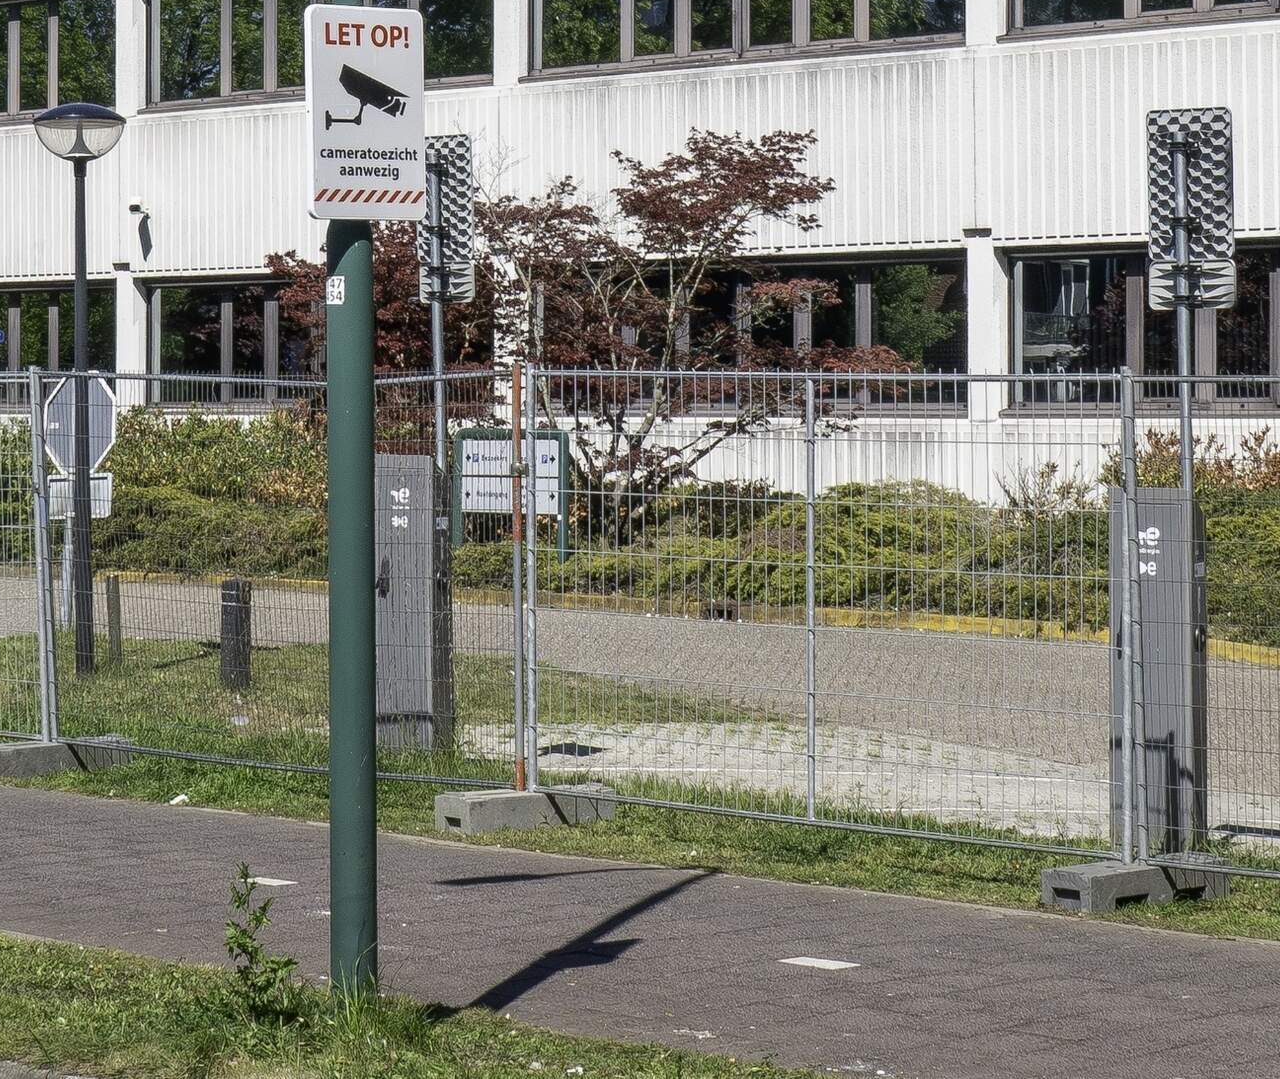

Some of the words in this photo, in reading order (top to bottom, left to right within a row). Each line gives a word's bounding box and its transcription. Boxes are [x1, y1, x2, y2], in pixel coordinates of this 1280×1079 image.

[325, 22, 365, 46] LET
[371, 24, 409, 49] OP!
[320, 147, 418, 160] cameratoezicht
[339, 164, 399, 181] aanwezig
